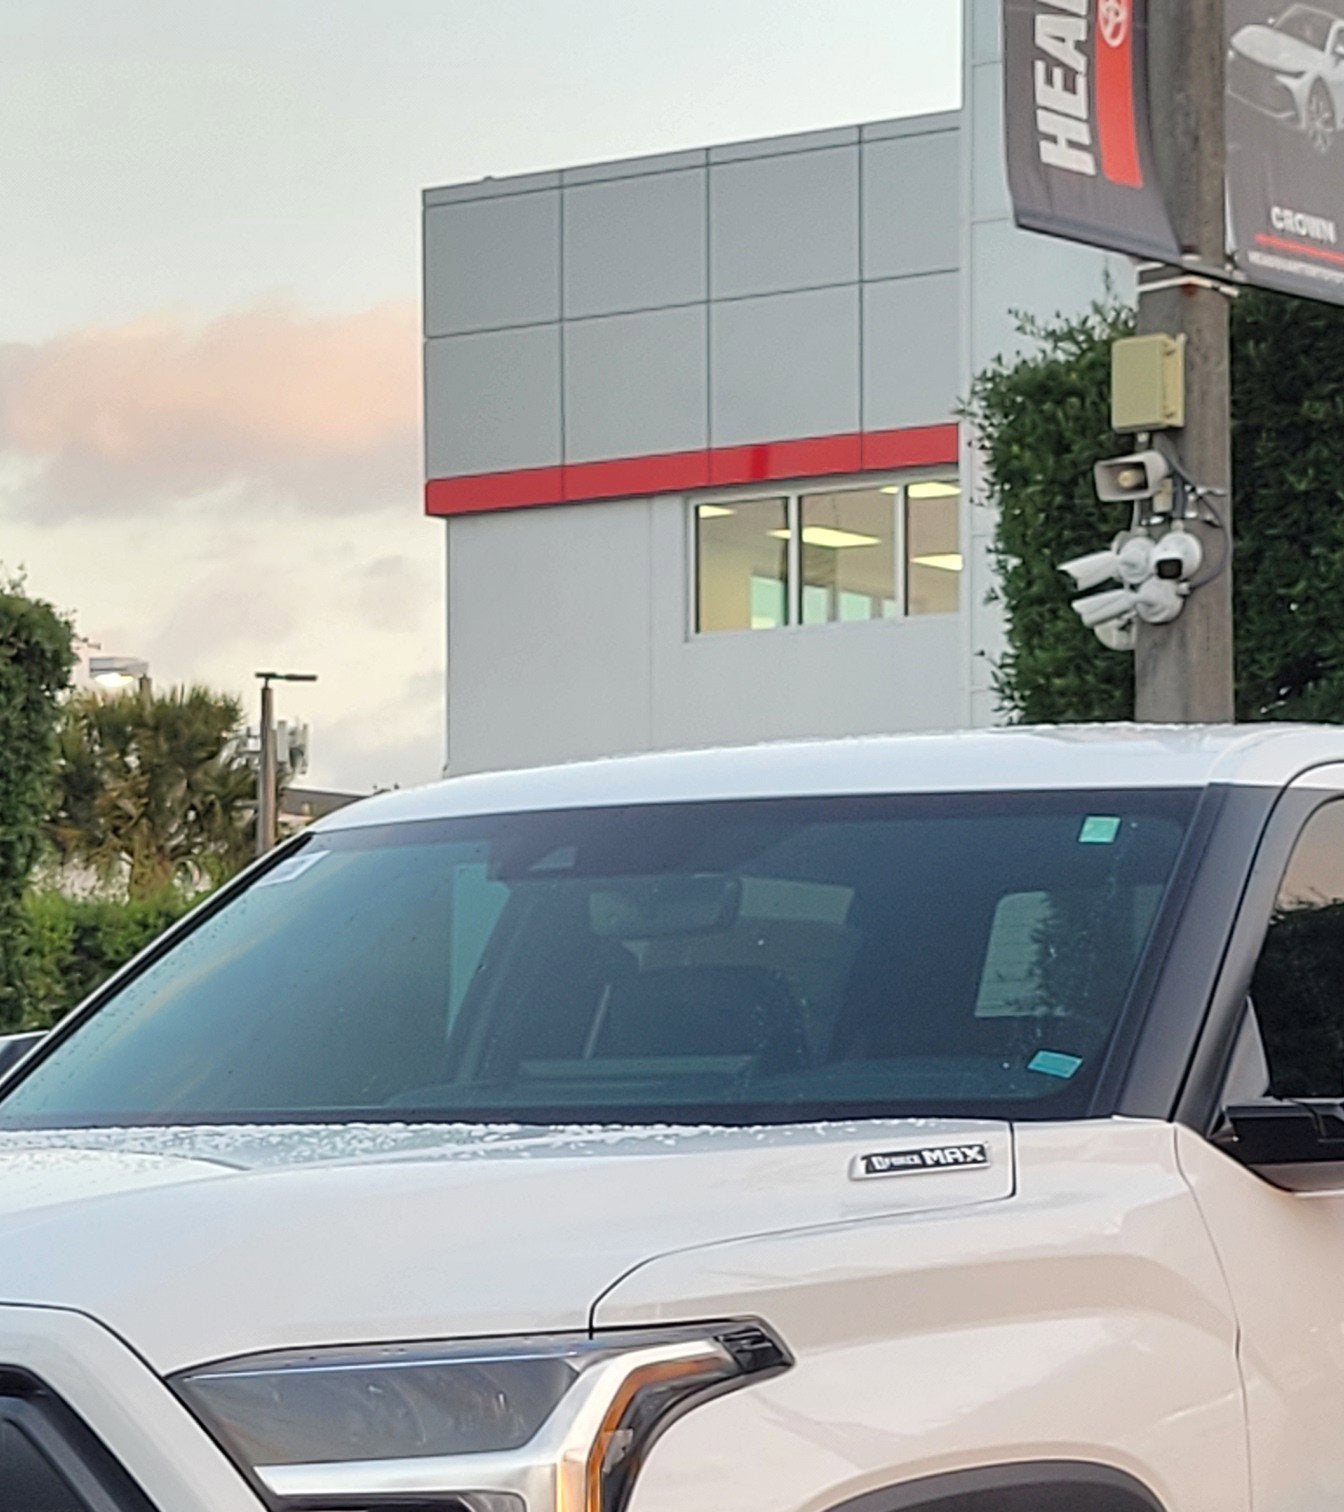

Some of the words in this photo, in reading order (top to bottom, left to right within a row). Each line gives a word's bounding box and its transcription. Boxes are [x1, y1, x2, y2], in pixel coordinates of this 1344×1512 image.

[1034, 0, 1096, 176] HEA
[1270, 205, 1338, 244] CROWN
[921, 1145, 985, 1167] MAX
